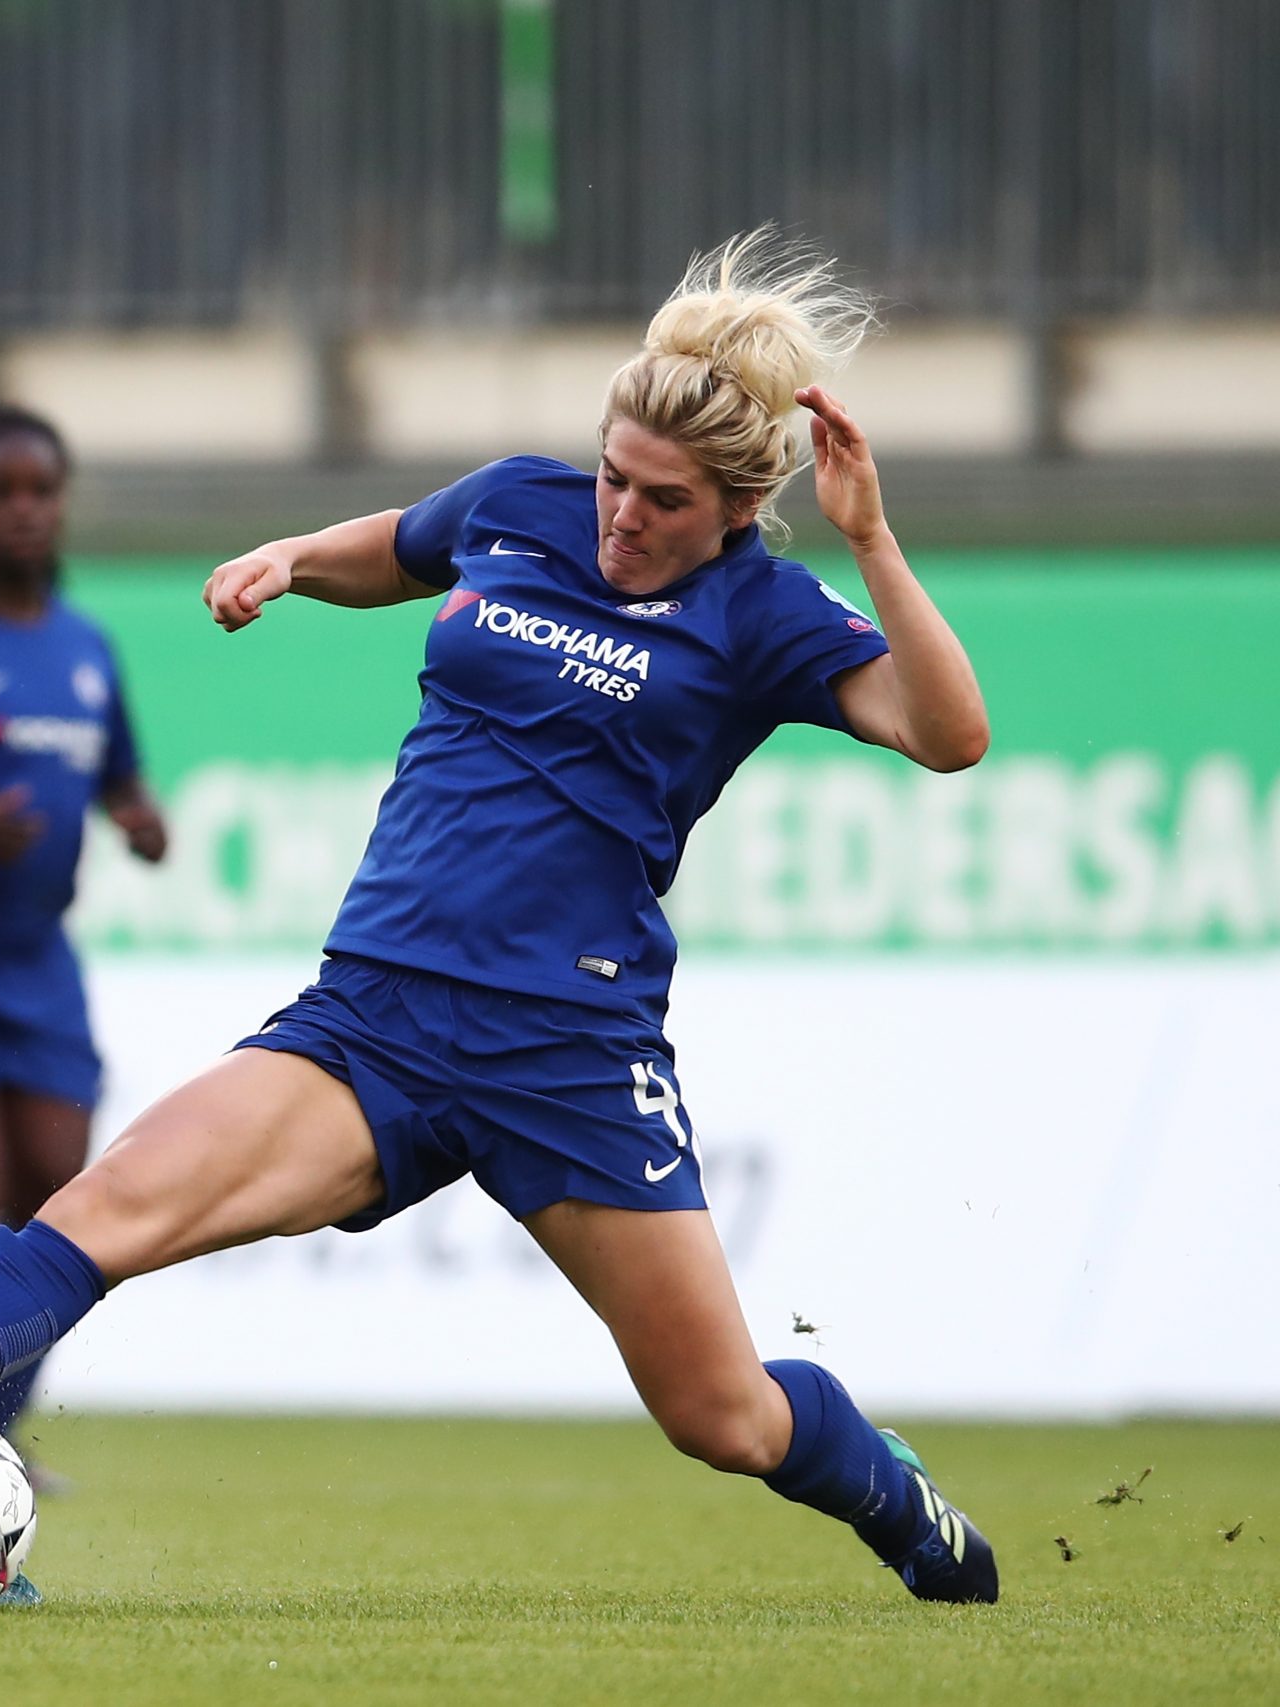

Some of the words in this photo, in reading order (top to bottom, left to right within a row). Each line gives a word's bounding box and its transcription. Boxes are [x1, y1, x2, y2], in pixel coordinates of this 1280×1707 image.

[474, 598, 651, 681] YOKOHAMA
[557, 657, 641, 702] TYRES
[629, 1061, 687, 1147] 4
